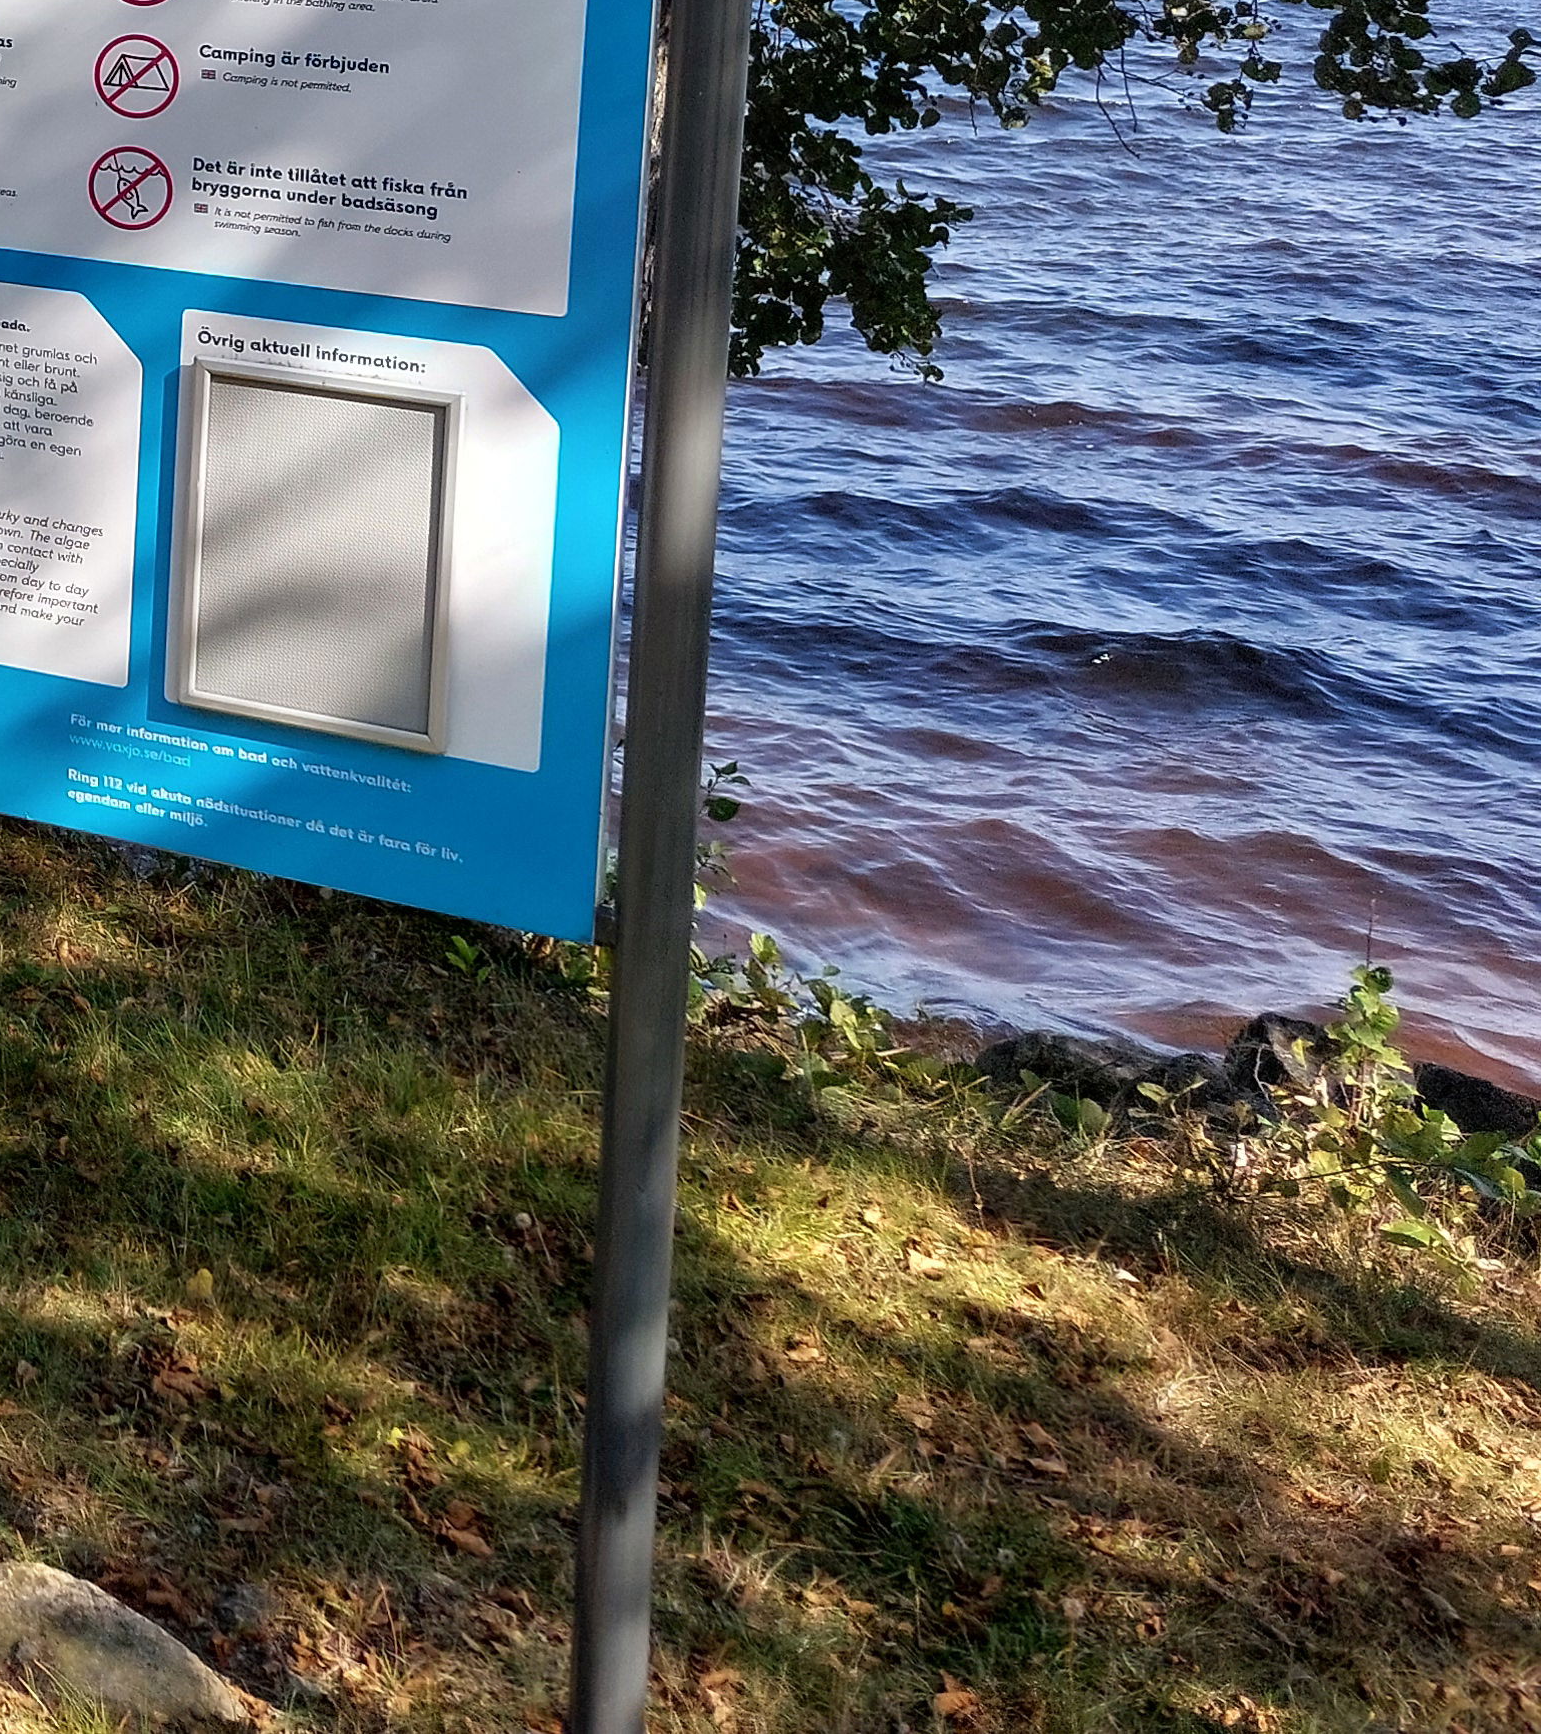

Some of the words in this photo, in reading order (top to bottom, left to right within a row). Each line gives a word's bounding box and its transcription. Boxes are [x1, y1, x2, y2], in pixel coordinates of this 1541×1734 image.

[198, 44, 275, 68] Camping
[280, 50, 300, 65] är
[304, 52, 389, 74] förbjuden
[222, 71, 268, 87] Camping
[191, 176, 281, 200] bryggorna
[286, 189, 336, 205] under
[340, 192, 438, 220] badsäsong
[192, 156, 222, 174] Det
[226, 160, 246, 175] är
[249, 162, 282, 180] inte
[287, 167, 346, 187] tillåtet
[350, 175, 377, 190] att
[381, 176, 424, 195] fiska
[429, 181, 467, 199] från
[197, 325, 244, 356] Övrig
[249, 337, 310, 358] aktuell
[315, 344, 425, 373] information:
[70, 713, 90, 726] För
[96, 721, 122, 733] mer
[126, 726, 208, 751] information
[211, 745, 234, 757] om
[237, 747, 267, 763] bad
[271, 756, 297, 769] och
[66, 789, 131, 809] egendom
[134, 801, 166, 817] eller
[67, 767, 99, 787] Ring
[102, 774, 122, 790] 112
[125, 781, 147, 795] vid
[150, 786, 192, 805] akuta
[195, 796, 301, 827] nödsituationer
[305, 819, 325, 833] då
[329, 826, 353, 839] det
[357, 829, 374, 843] är
[379, 834, 410, 851] fara
[415, 841, 436, 855] för
